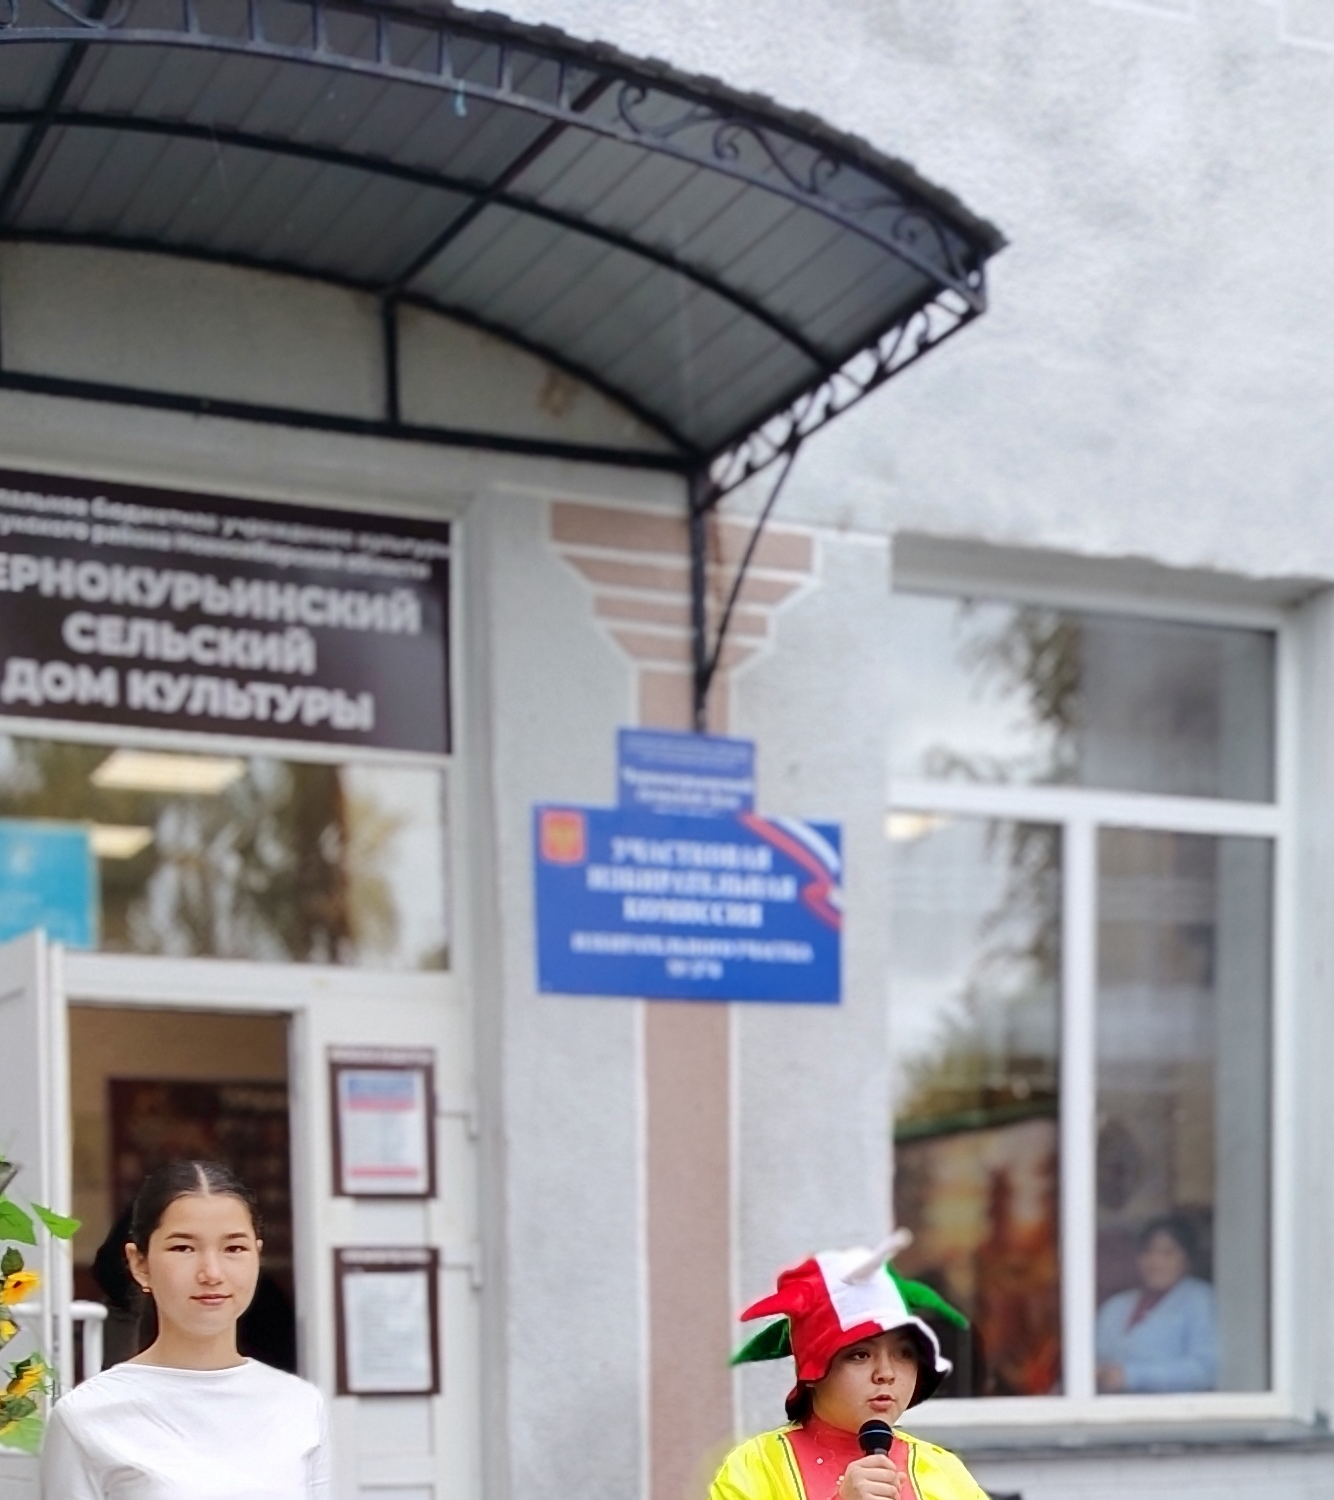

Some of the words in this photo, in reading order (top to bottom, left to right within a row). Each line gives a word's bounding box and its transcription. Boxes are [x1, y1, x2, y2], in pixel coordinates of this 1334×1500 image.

[63, 611, 317, 675] СЕЛЬСКИЙ
[0, 656, 119, 710] ДОМ
[127, 667, 375, 731] КУЛЬТУРЫ
